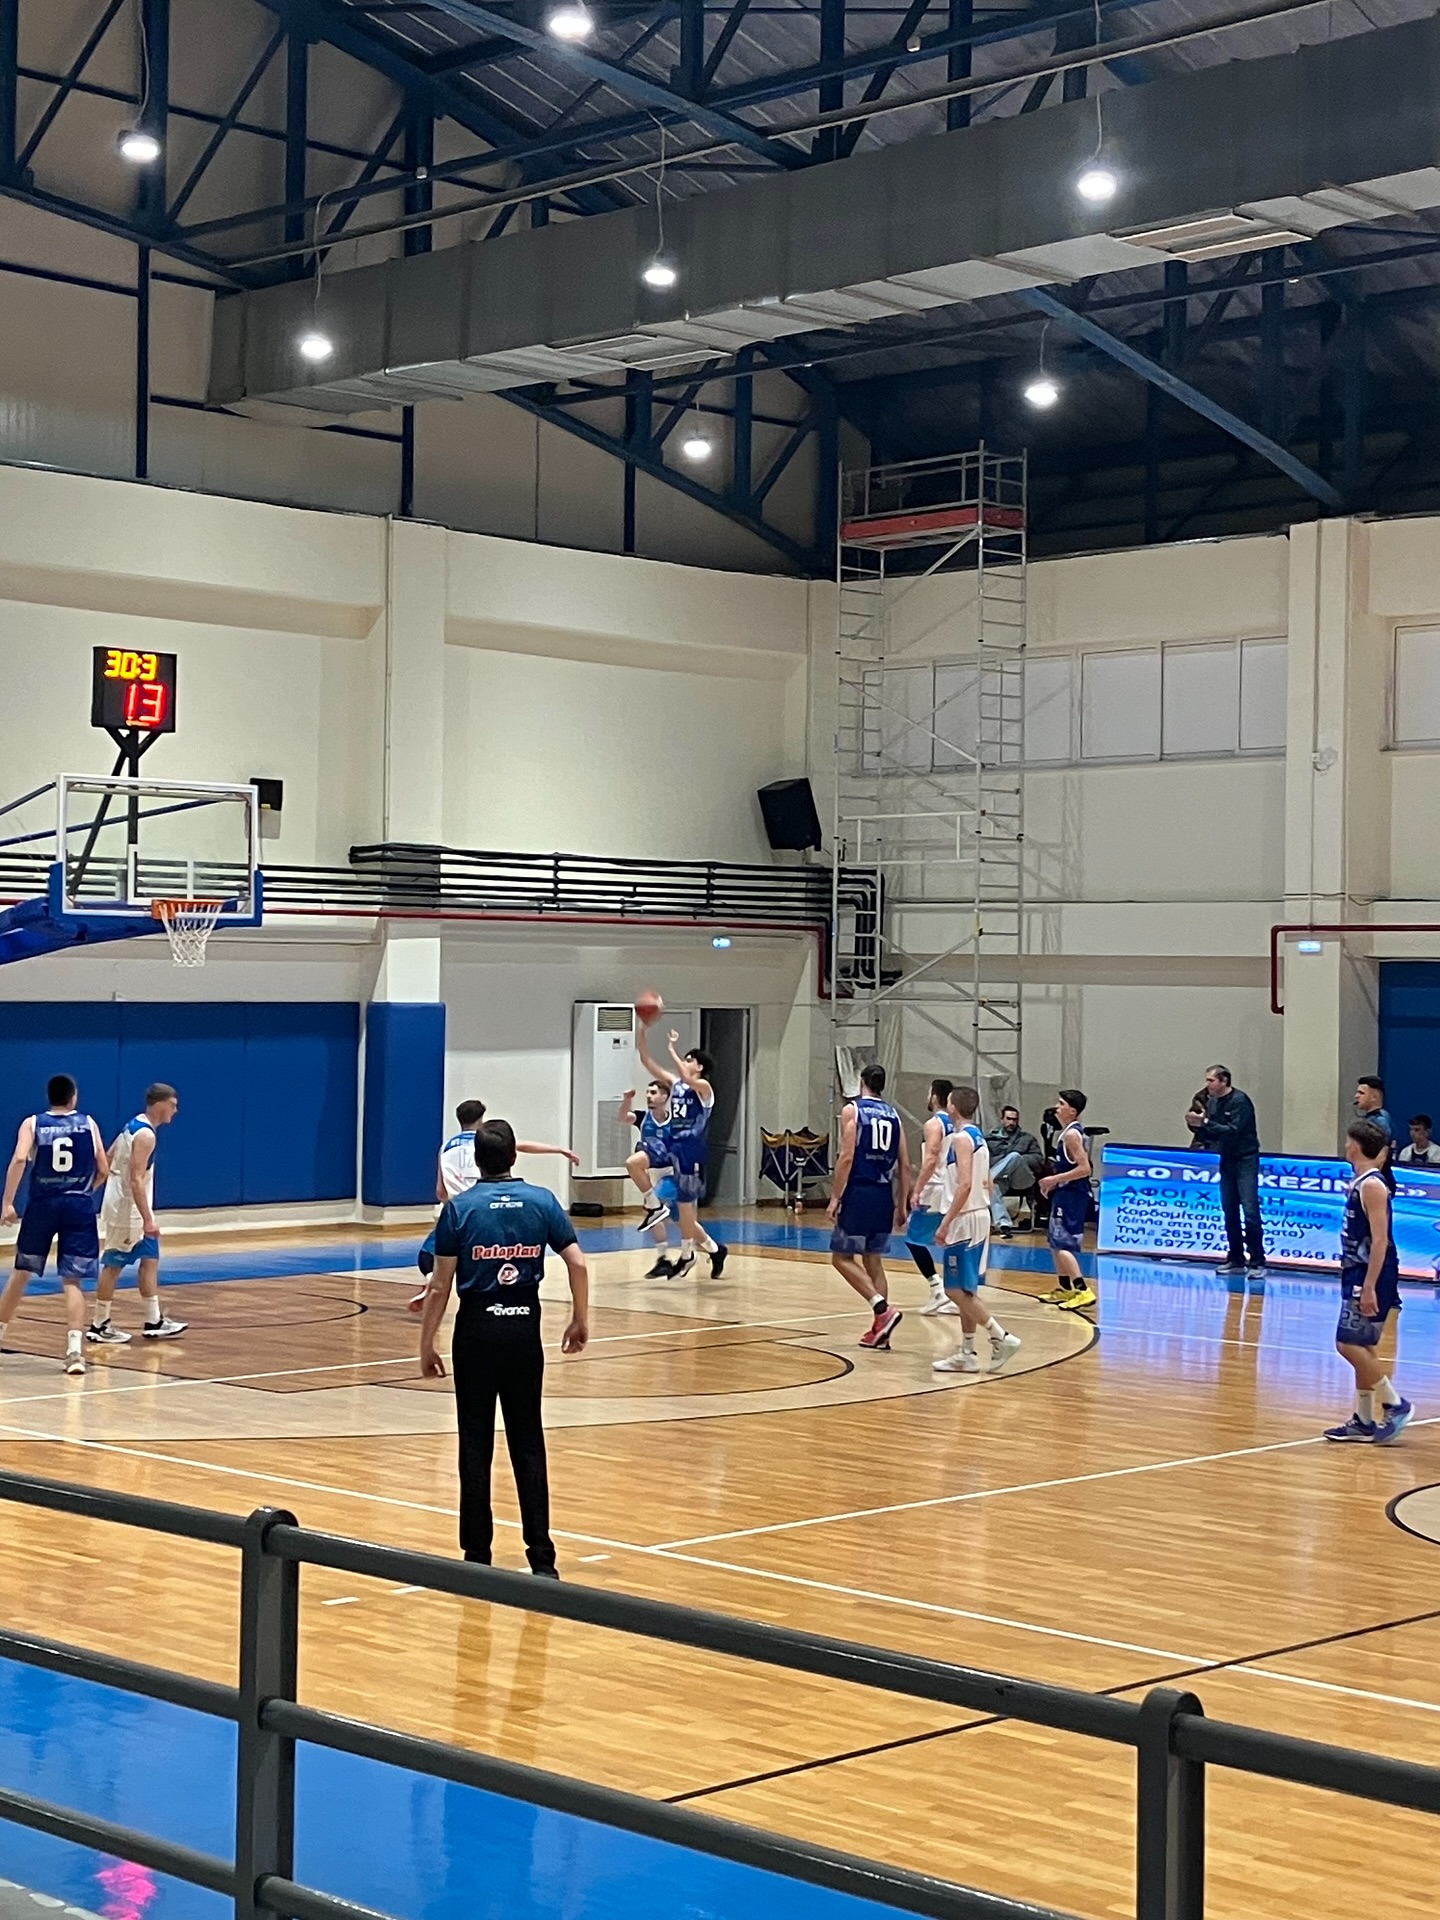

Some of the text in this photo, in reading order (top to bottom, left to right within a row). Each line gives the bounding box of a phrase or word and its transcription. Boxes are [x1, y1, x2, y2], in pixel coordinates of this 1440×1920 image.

[124, 683, 164, 722] 13
[673, 1103, 687, 1118] 24
[871, 1117, 892, 1151] 10
[52, 1137, 73, 1172] 6
[1117, 1206, 1221, 1222] Καρδαμίτσια
[1119, 1196, 1168, 1207] Τέρμα
[1260, 1208, 1338, 1221] ταιρείας,
[1160, 1228, 1215, 1241] 26510
[1153, 1239, 1196, 1249] 6977
[1280, 1249, 1326, 1260] 6946
